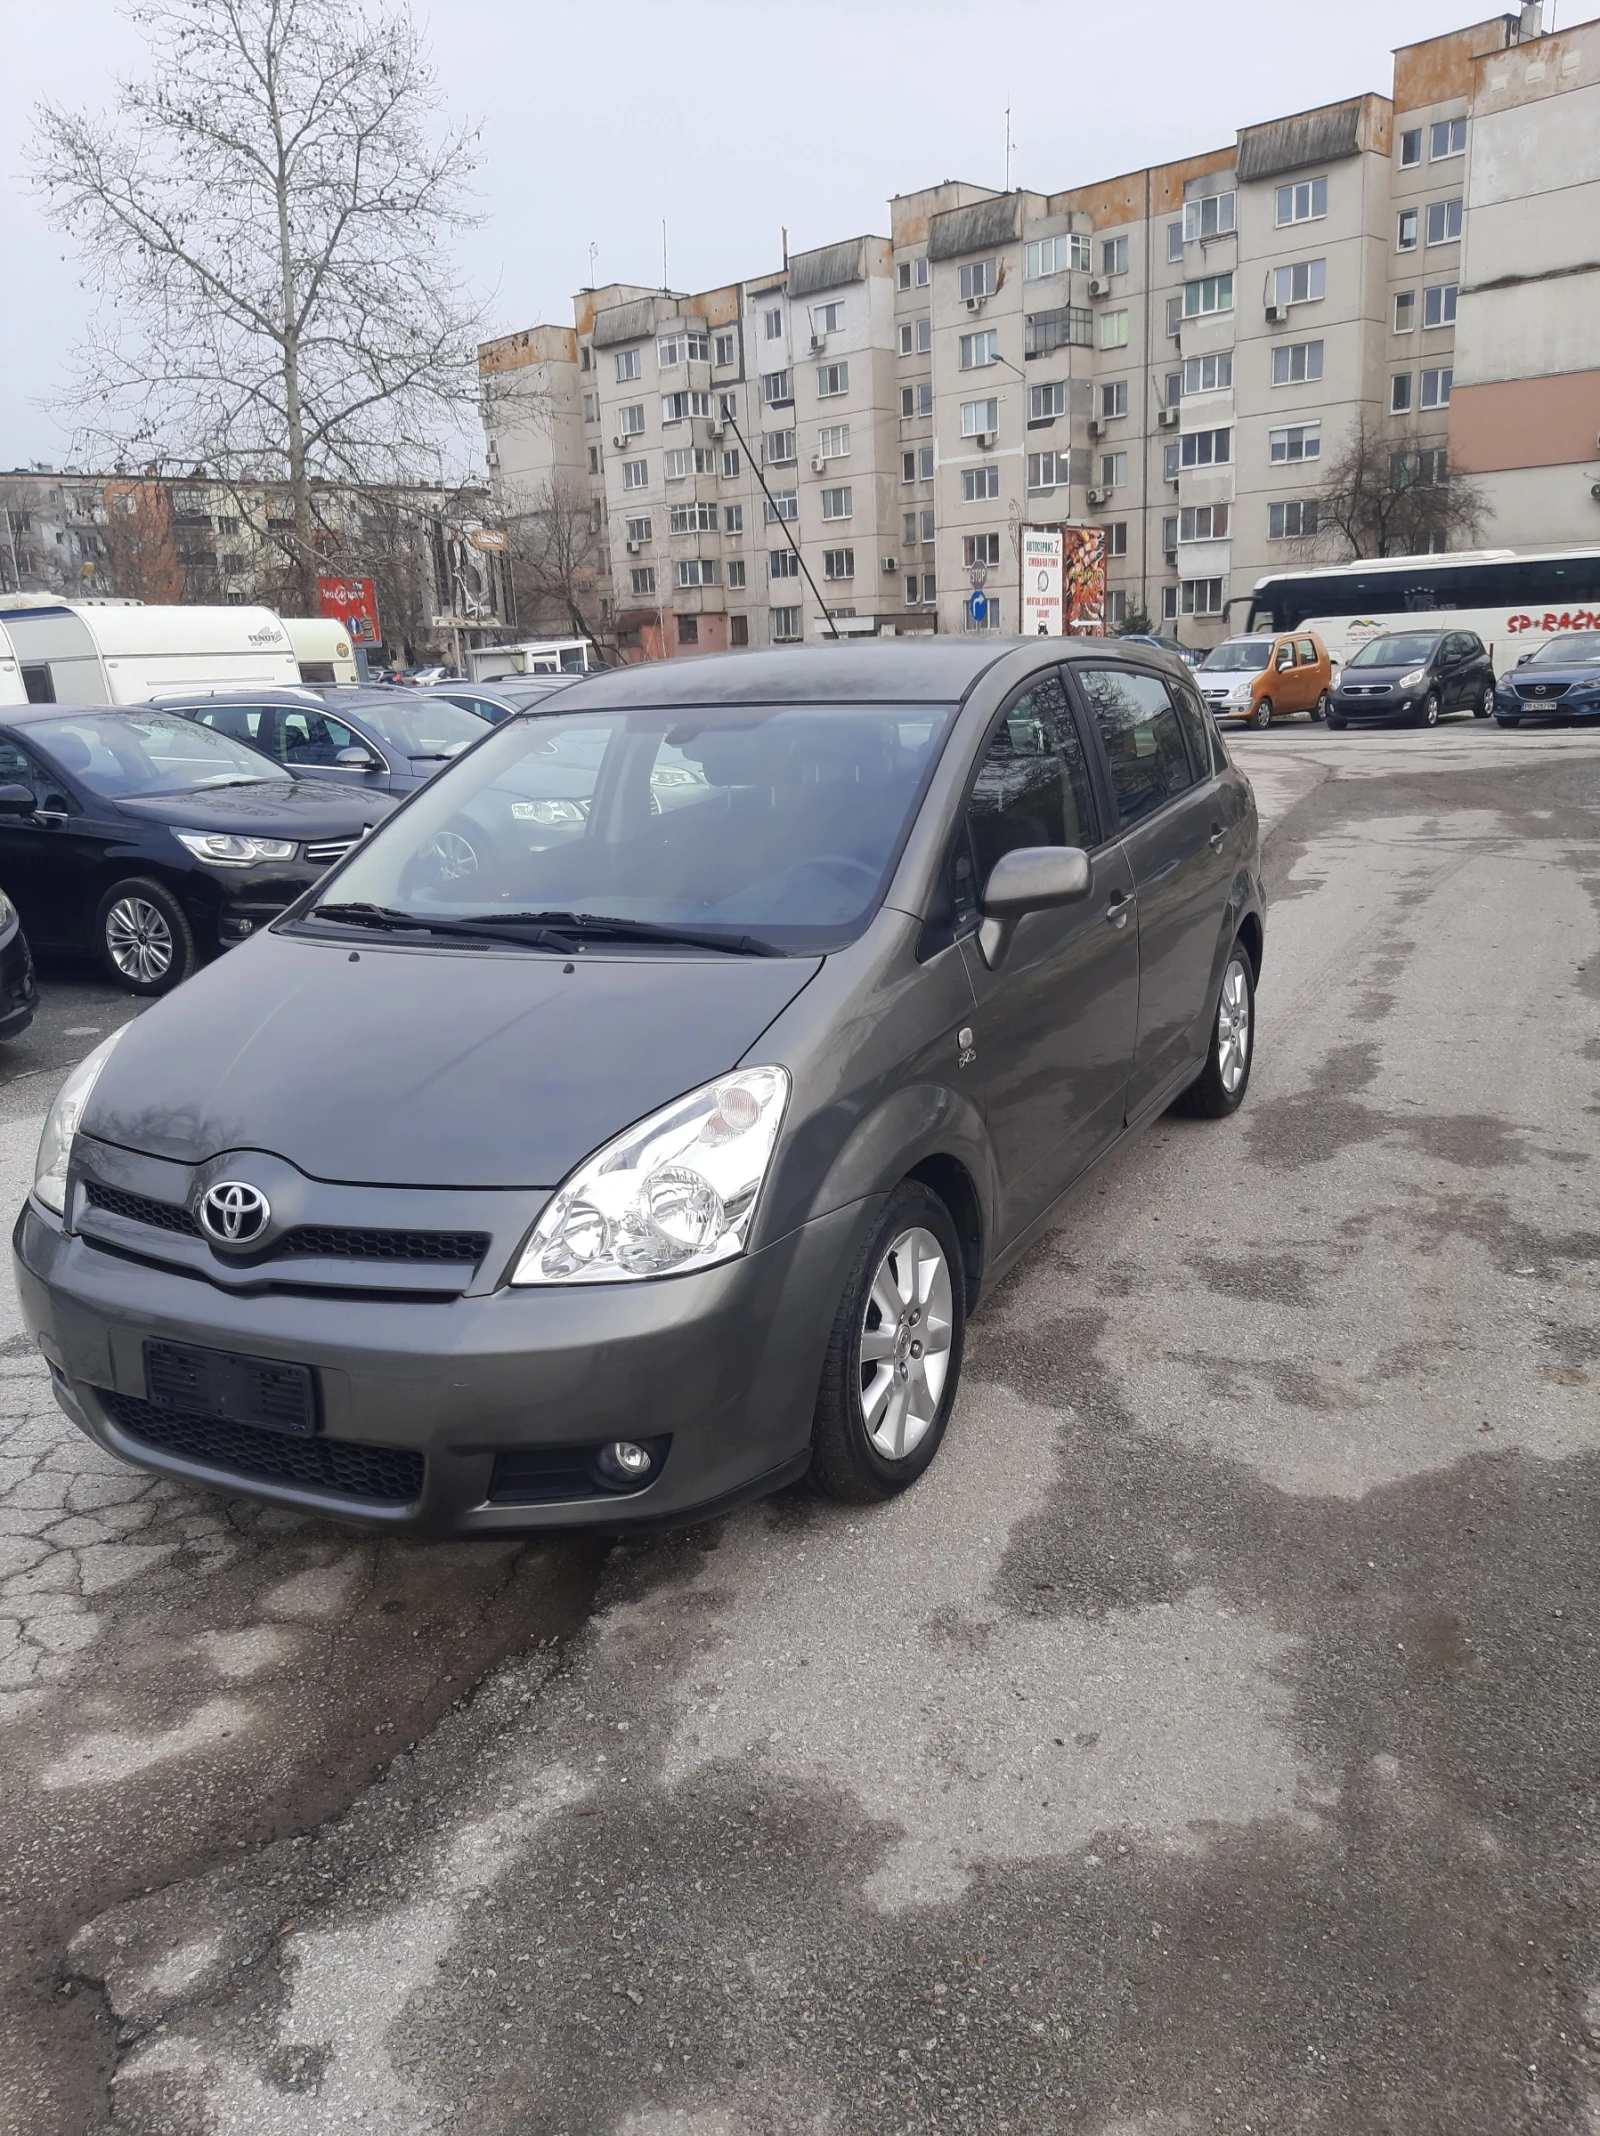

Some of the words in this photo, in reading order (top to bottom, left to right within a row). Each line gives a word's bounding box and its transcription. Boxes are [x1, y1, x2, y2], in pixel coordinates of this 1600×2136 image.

[970, 569, 986, 582] STOP
[1430, 603, 1457, 611] CLASS
[247, 634, 275, 642] FENDT
